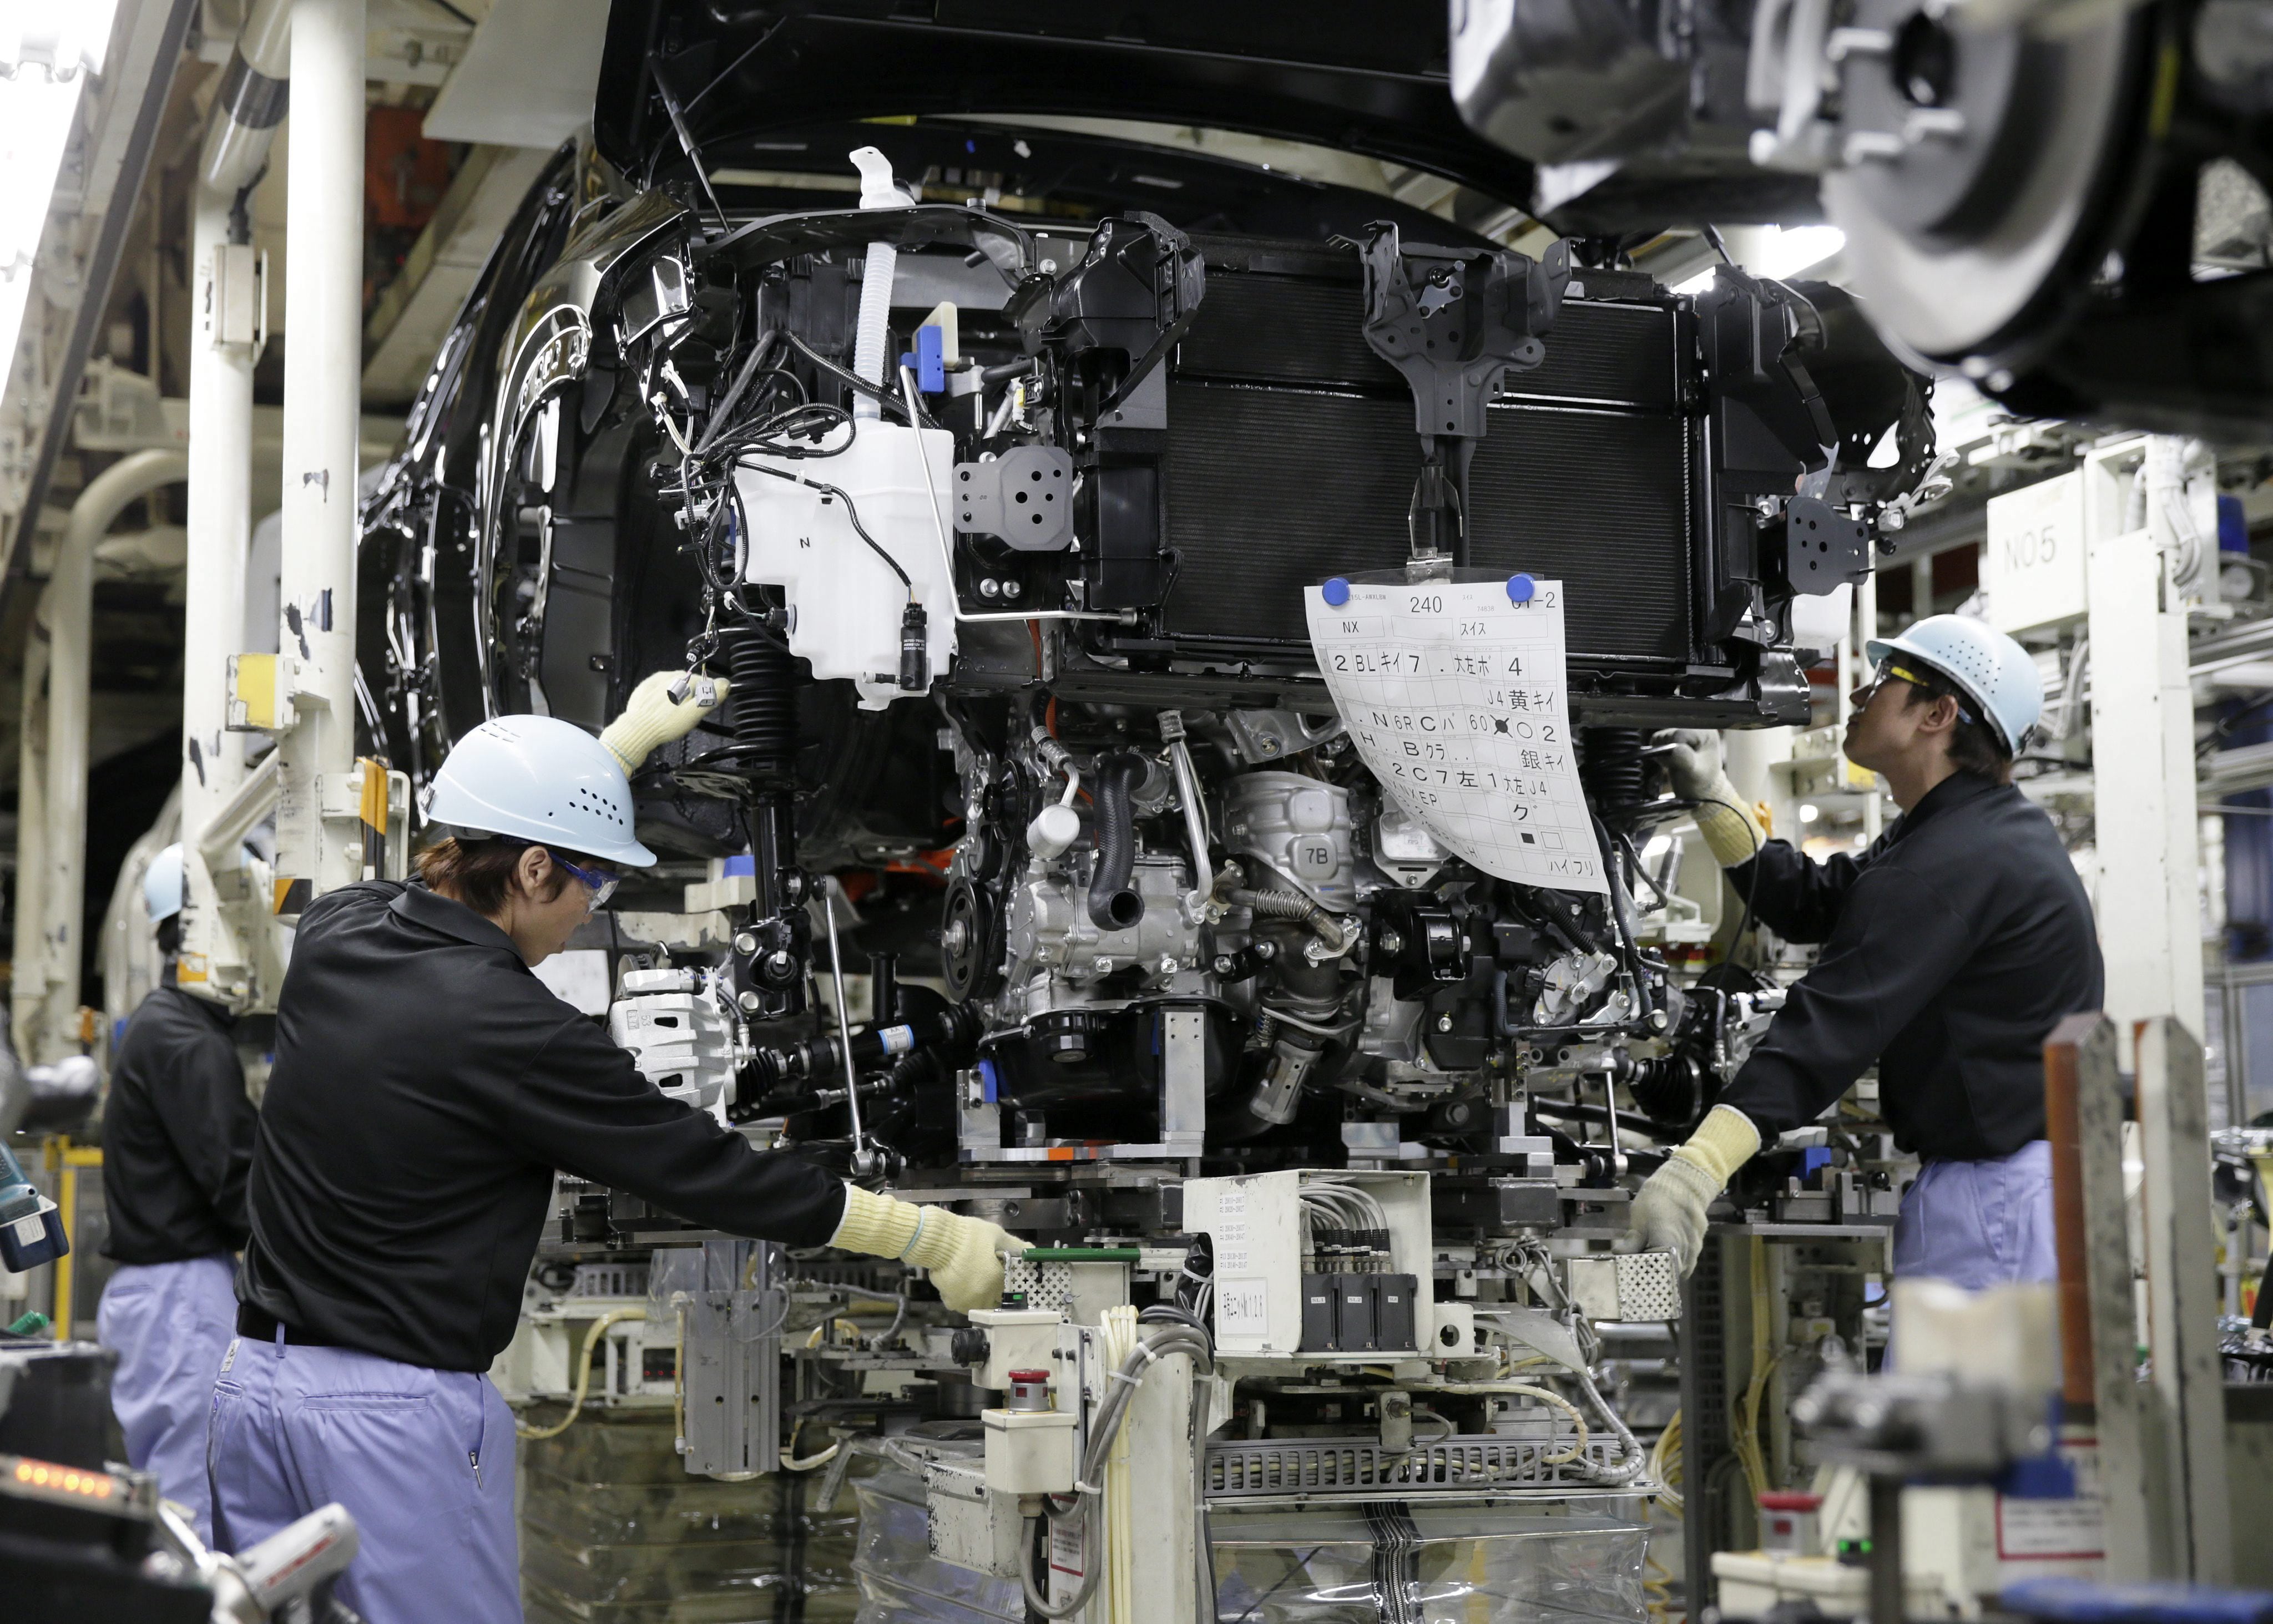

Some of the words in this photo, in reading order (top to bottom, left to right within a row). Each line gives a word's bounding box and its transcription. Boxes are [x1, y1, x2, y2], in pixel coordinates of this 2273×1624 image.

[800, 537, 811, 549] N
[2004, 525, 2056, 574] NO5
[1410, 596, 1442, 613] 240
[1342, 621, 1360, 634] NX
[1461, 621, 1486, 636] スイス
[1335, 655, 1348, 671] 2
[1355, 655, 1376, 672] BL
[1408, 655, 1420, 672] 7
[1508, 657, 1522, 676] 4
[1508, 690, 1529, 711] 黄
[1372, 712, 1388, 727] N
[1394, 715, 1414, 731] 6R
[1420, 716, 1436, 731] C
[1469, 714, 1488, 731] 60
[1543, 725, 1556, 742] 2
[1360, 731, 1376, 747] H
[1403, 741, 1420, 756] B
[1521, 749, 1542, 770] 銀
[1392, 762, 1406, 777] 2
[1412, 767, 1428, 781] C
[1456, 770, 1478, 787] 左
[1305, 847, 1328, 864] 7B
